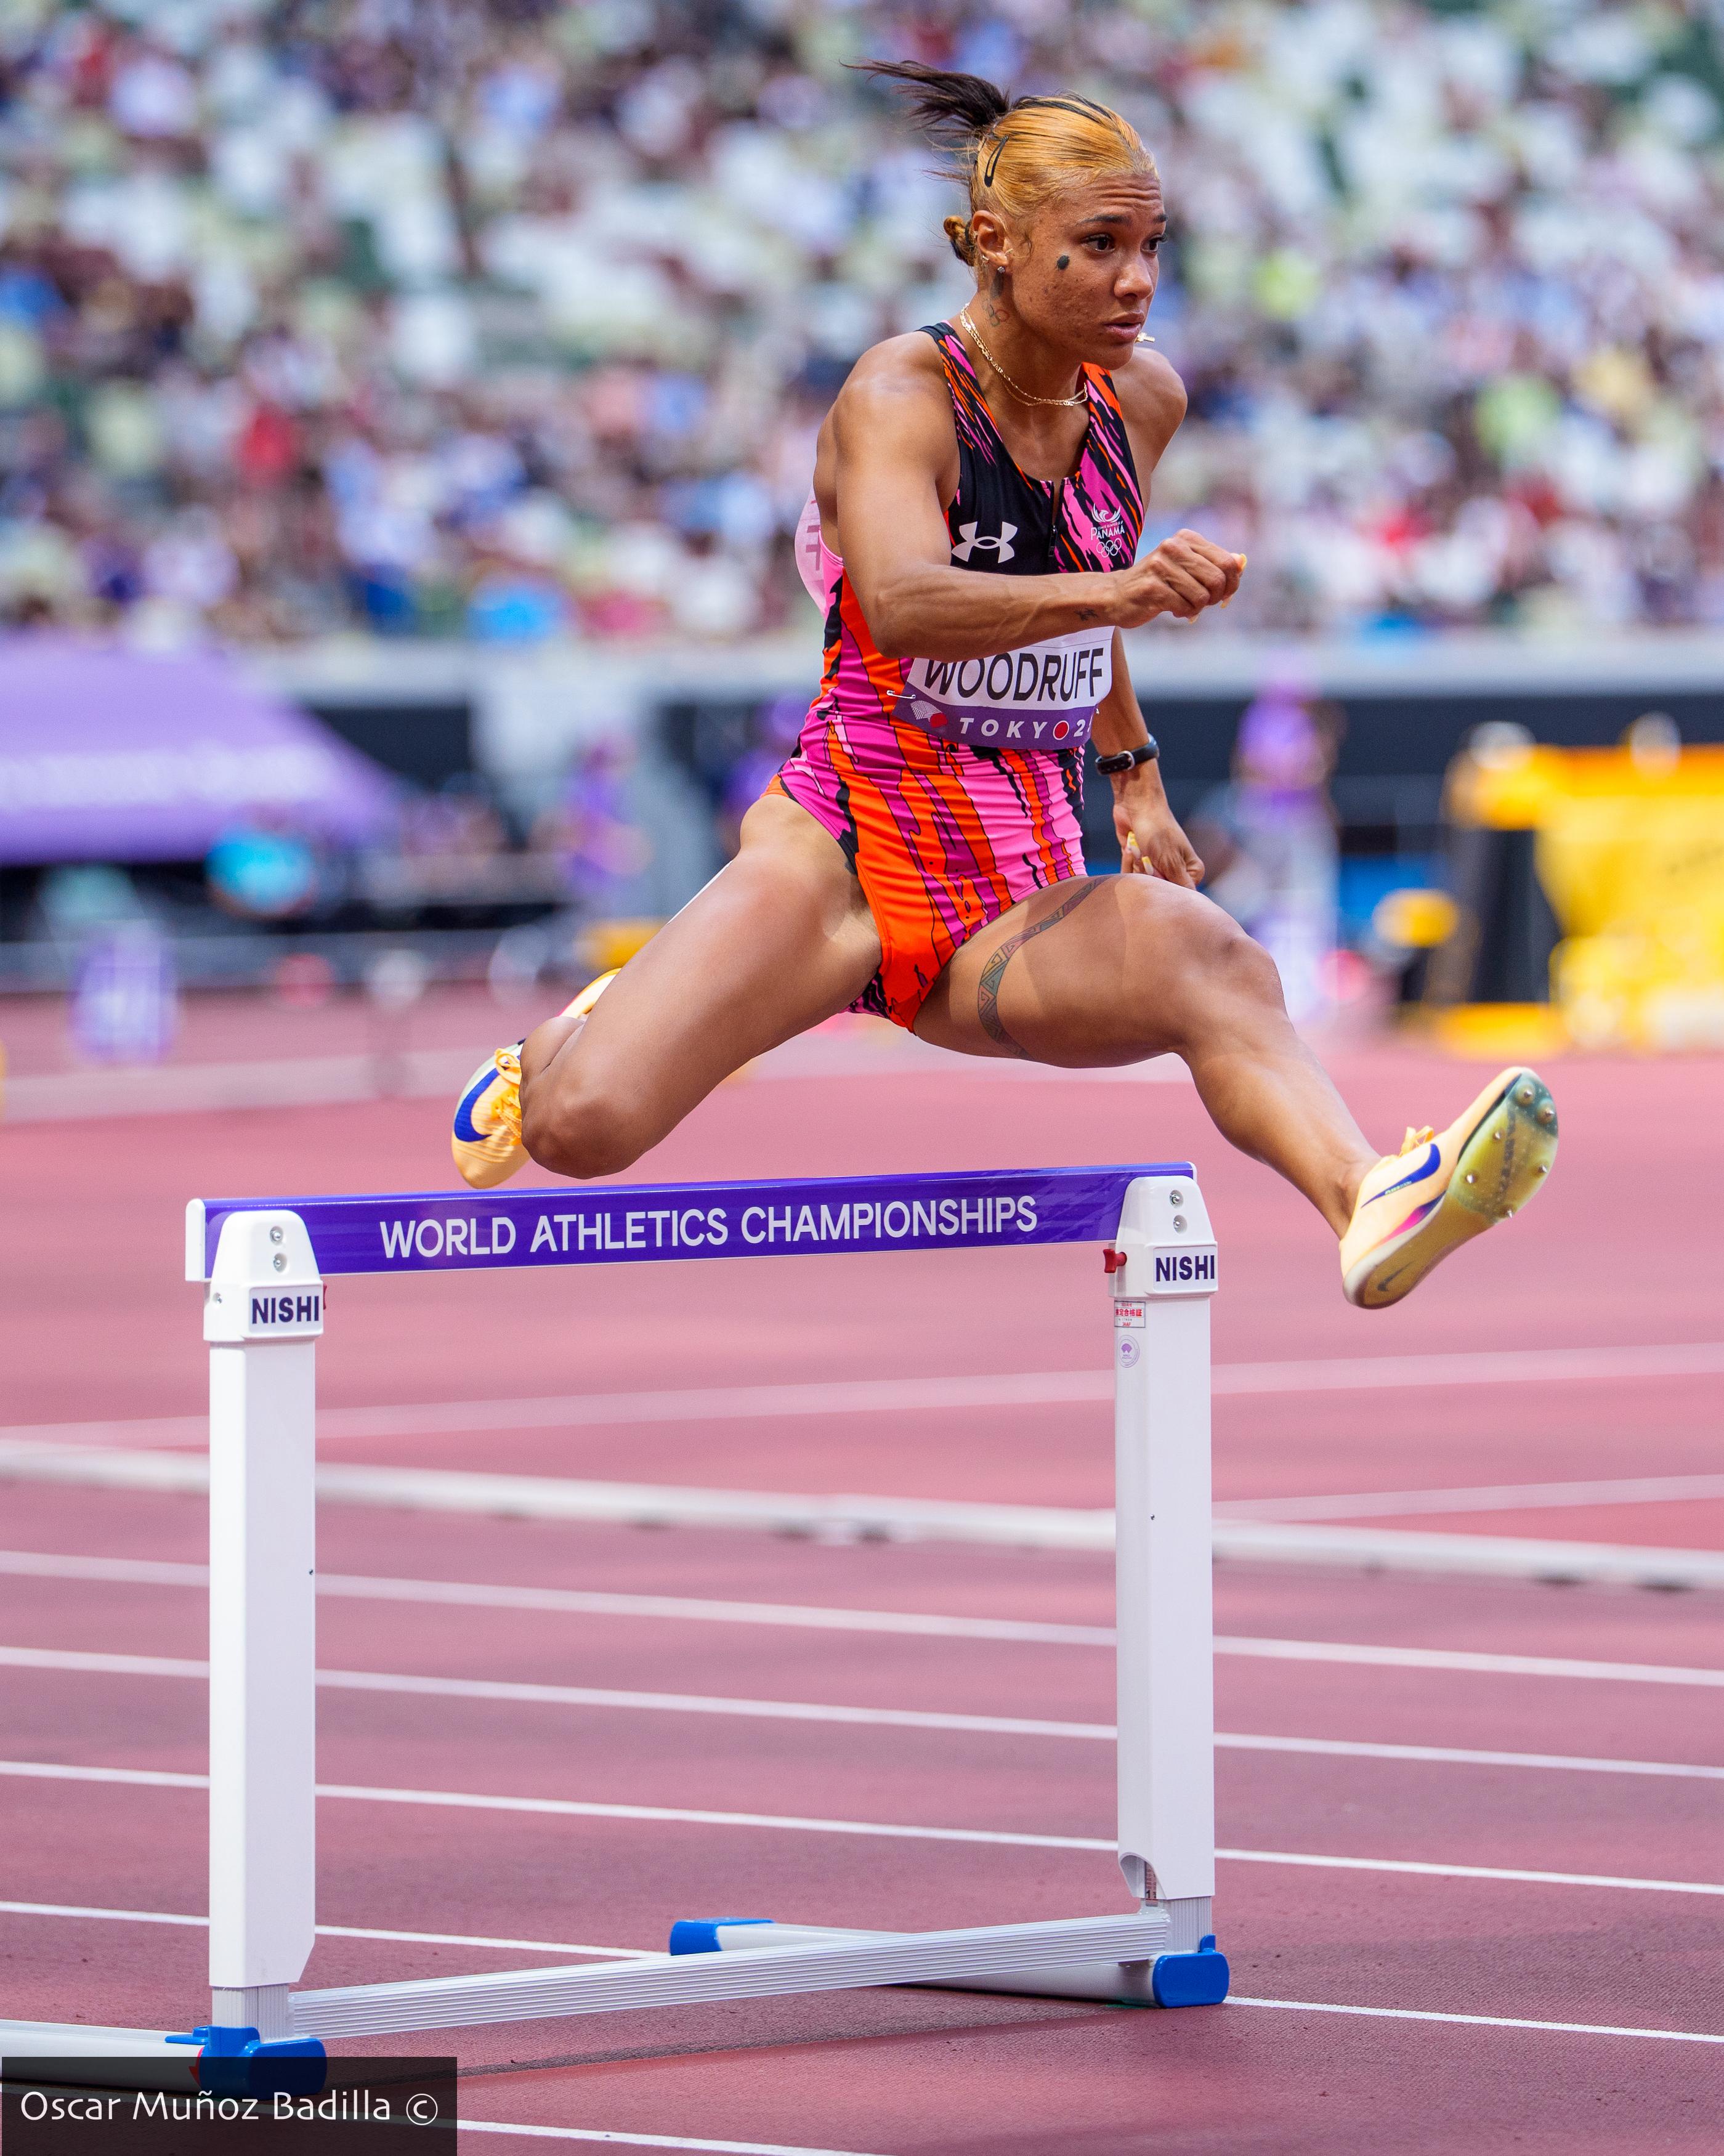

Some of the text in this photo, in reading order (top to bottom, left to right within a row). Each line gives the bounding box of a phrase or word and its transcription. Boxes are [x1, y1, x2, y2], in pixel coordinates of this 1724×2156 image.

[925, 648, 1104, 702] WOODRUFF
[379, 1195, 1038, 1258] WORLD ATHLETICS CHAMPIONSHIPS
[1155, 1255, 1215, 1282] NISHI
[252, 1296, 320, 1324] NISHI
